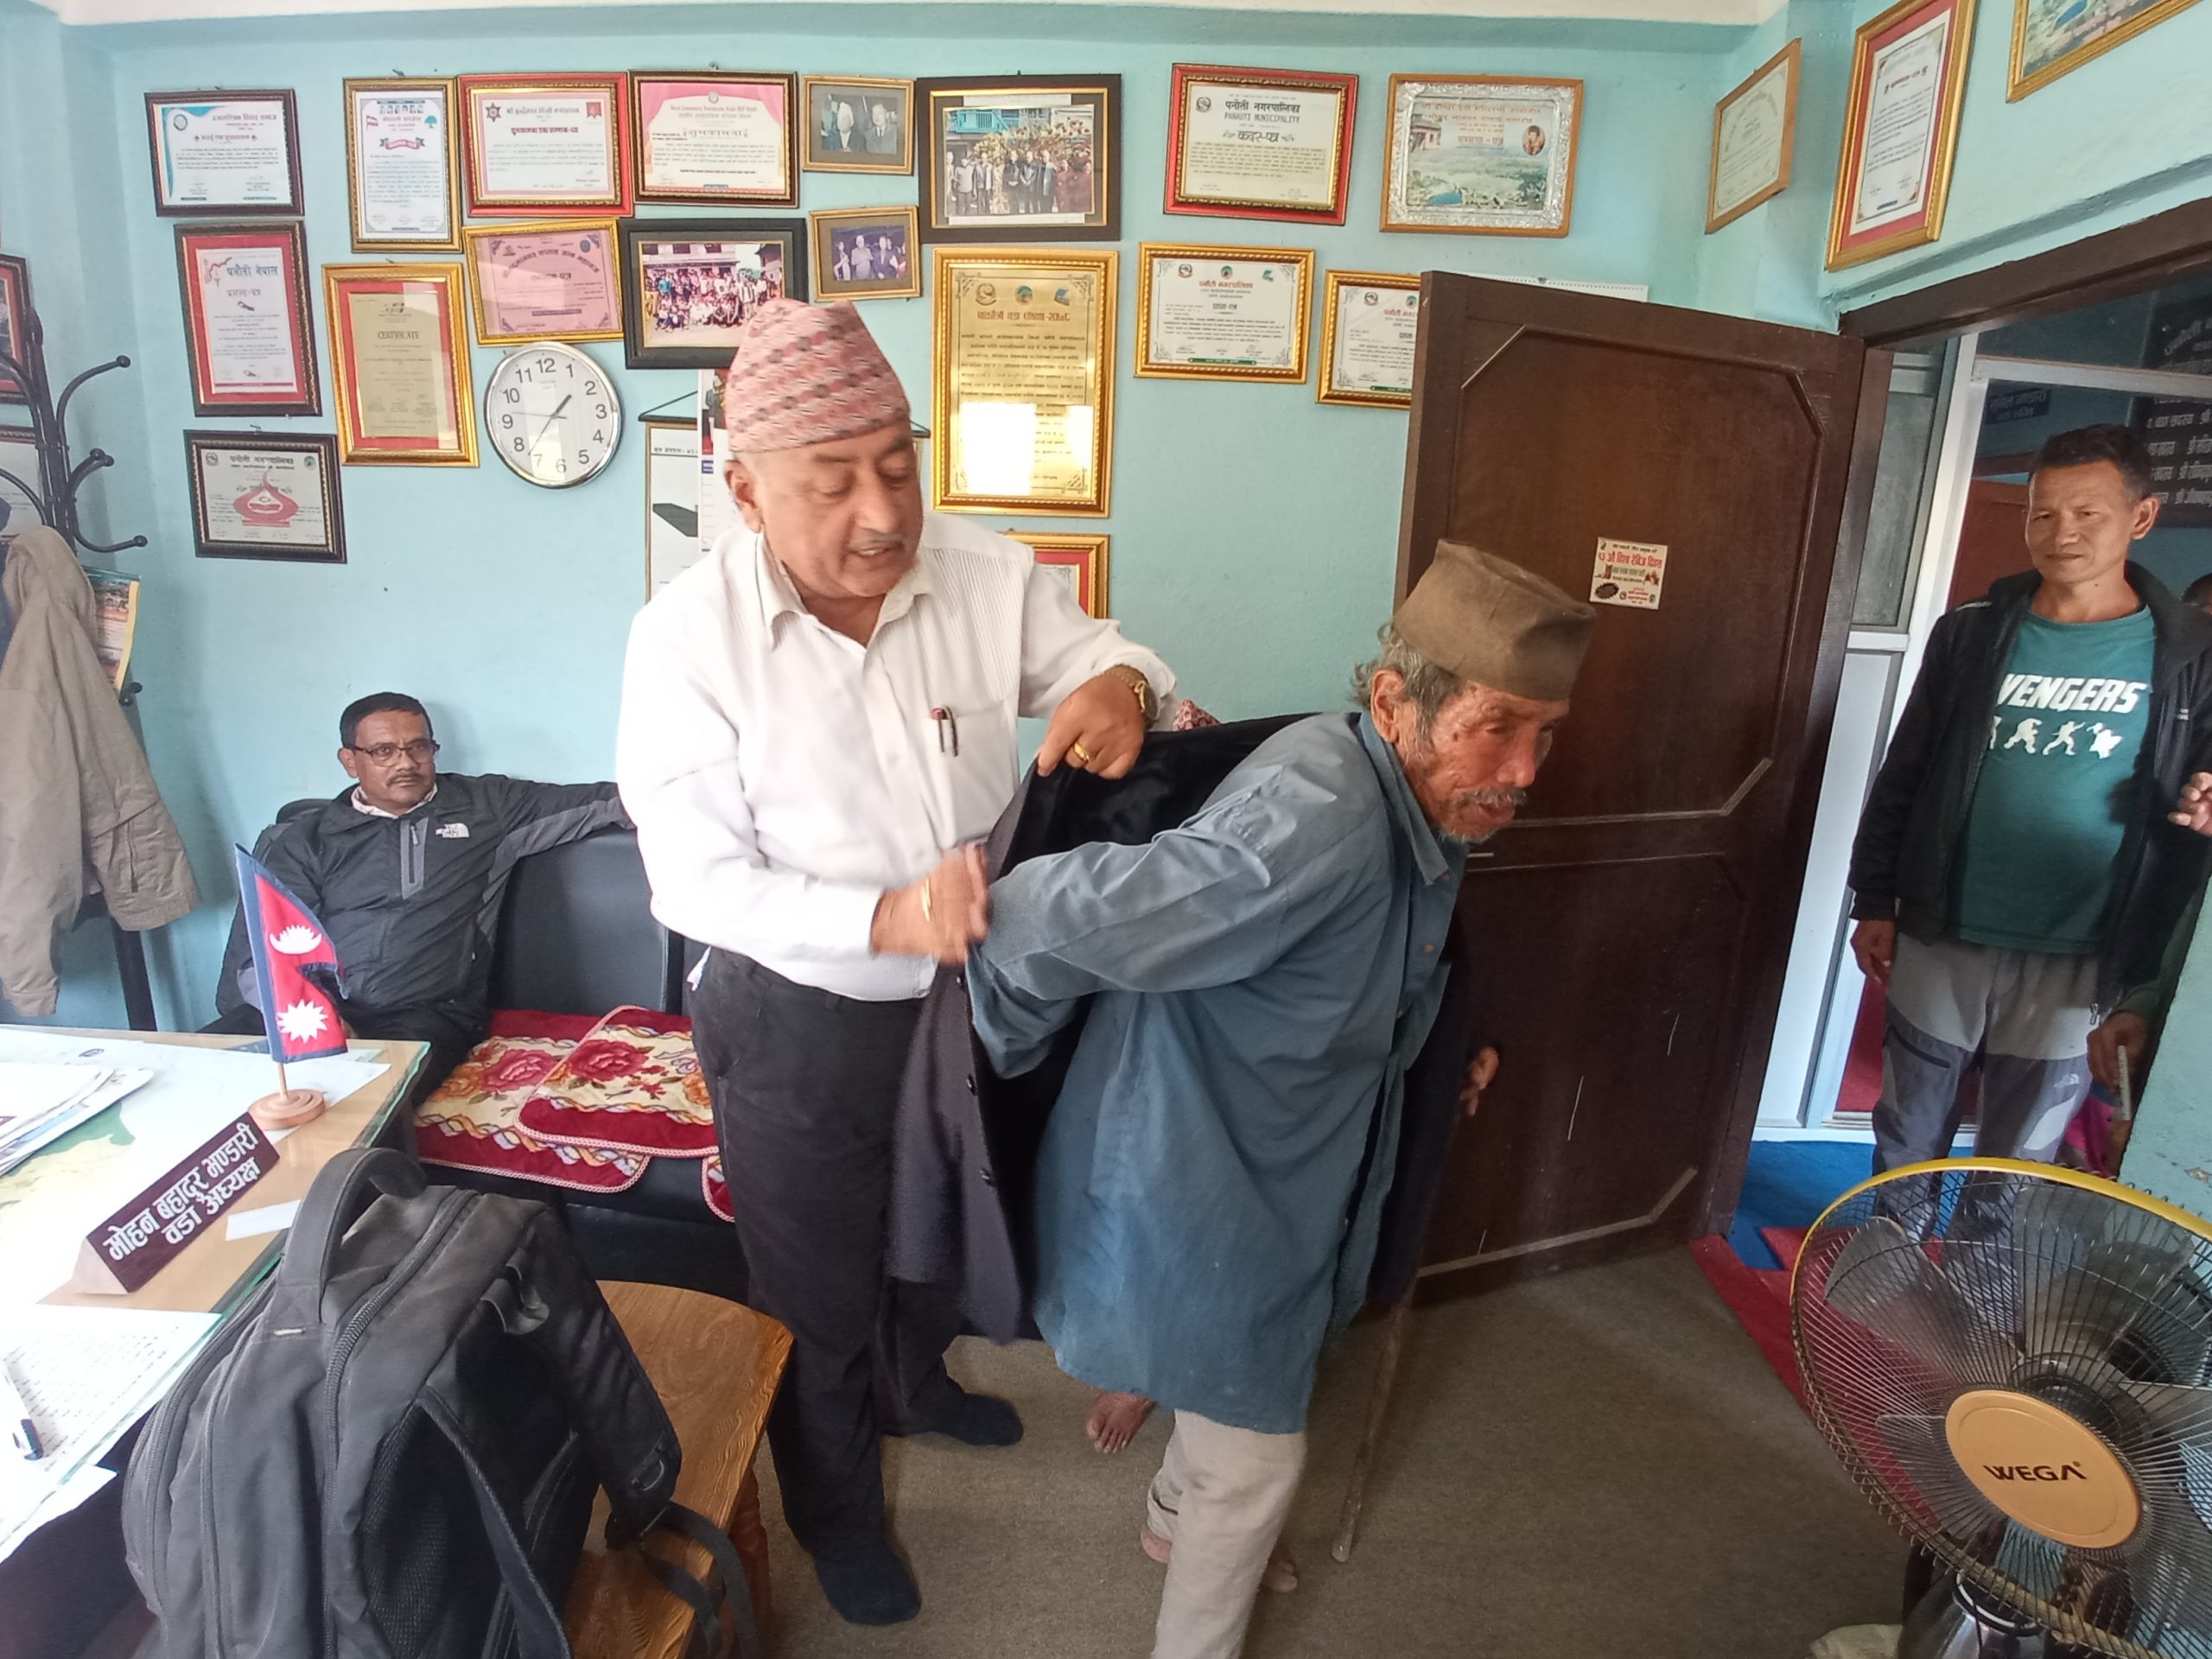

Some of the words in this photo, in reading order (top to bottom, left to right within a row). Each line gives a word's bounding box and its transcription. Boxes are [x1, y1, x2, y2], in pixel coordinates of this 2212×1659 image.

[1224, 99, 1249, 111] पनौती
[1253, 101, 1301, 113] नगरपालिका
[1254, 113, 1300, 124] MUNICIPALITY
[255, 264, 278, 276] नेपाल
[377, 330, 420, 340] CERTIFICATE
[535, 358, 556, 374] 12
[565, 363, 574, 378] 1
[516, 367, 533, 384] 11
[502, 387, 520, 404] 10
[584, 380, 597, 396] 2
[594, 404, 607, 419] 3
[501, 414, 513, 429] 9
[513, 436, 525, 453] 8
[593, 429, 604, 444] 4
[533, 453, 543, 467] 7
[578, 449, 590, 465] 5
[556, 458, 567, 474] 6
[1996, 673, 2149, 714] VENGERS
[102, 1207, 161, 1262] मोहन
[152, 1166, 209, 1219] बहादुर
[201, 1122, 259, 1179] भण्डारी
[161, 1205, 203, 1245] वडा
[200, 1156, 261, 1216] अध्यक्ष
[1982, 1463, 2088, 1482] WEGA
